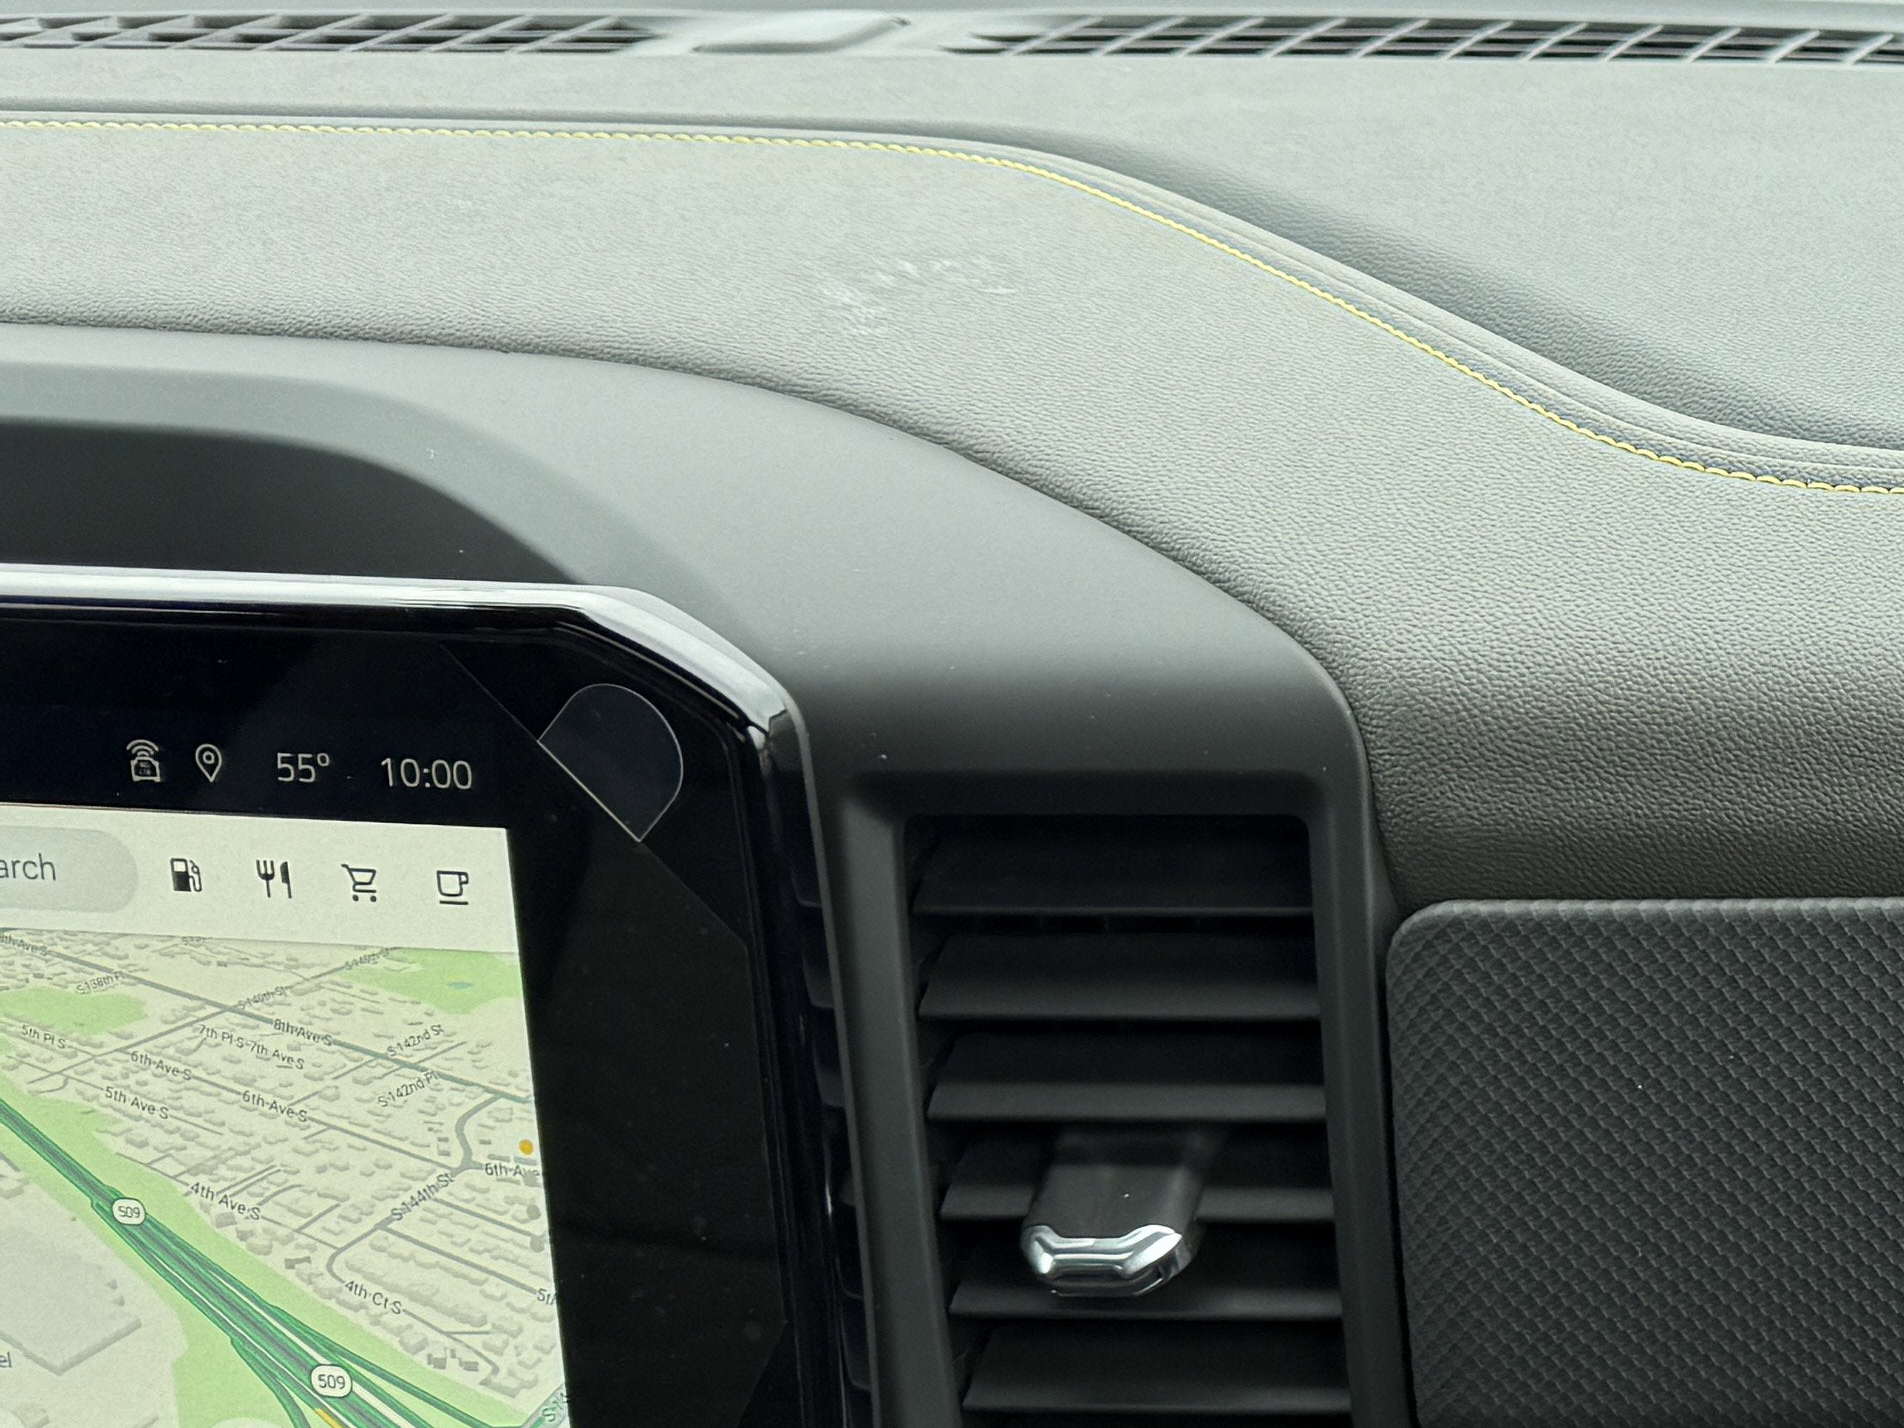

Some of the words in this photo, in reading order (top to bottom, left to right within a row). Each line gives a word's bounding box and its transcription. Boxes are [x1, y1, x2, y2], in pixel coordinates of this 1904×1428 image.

[381, 757, 473, 790] 10:00
[21, 1025, 40, 1041] 5th
[43, 1033, 55, 1046] Pl
[56, 1036, 67, 1050] S
[387, 1045, 397, 1058] S
[396, 1027, 430, 1053] 142nd
[430, 1024, 445, 1036] St
[130, 1051, 153, 1068] 6th
[155, 1058, 180, 1078] Ave
[182, 1068, 193, 1082] S
[105, 1086, 128, 1104] 5th
[130, 1094, 157, 1115] Ave
[158, 1105, 170, 1120] S
[242, 1089, 265, 1109] 6th
[268, 1098, 295, 1118] Ave
[297, 1109, 308, 1123] S
[377, 1095, 389, 1109] S
[389, 1078, 426, 1104] 142nd
[484, 1163, 508, 1178] 6th
[117, 1205, 142, 1220] 509
[189, 1181, 215, 1202] 4th
[217, 1192, 247, 1214] Ave
[249, 1206, 263, 1221] S
[390, 1207, 404, 1222] S
[402, 1183, 439, 1215] 144th
[436, 1172, 455, 1188] St
[345, 1280, 368, 1301] 4th
[371, 1292, 391, 1311] Ct
[390, 1300, 404, 1316] S
[316, 1373, 347, 1391] 509
